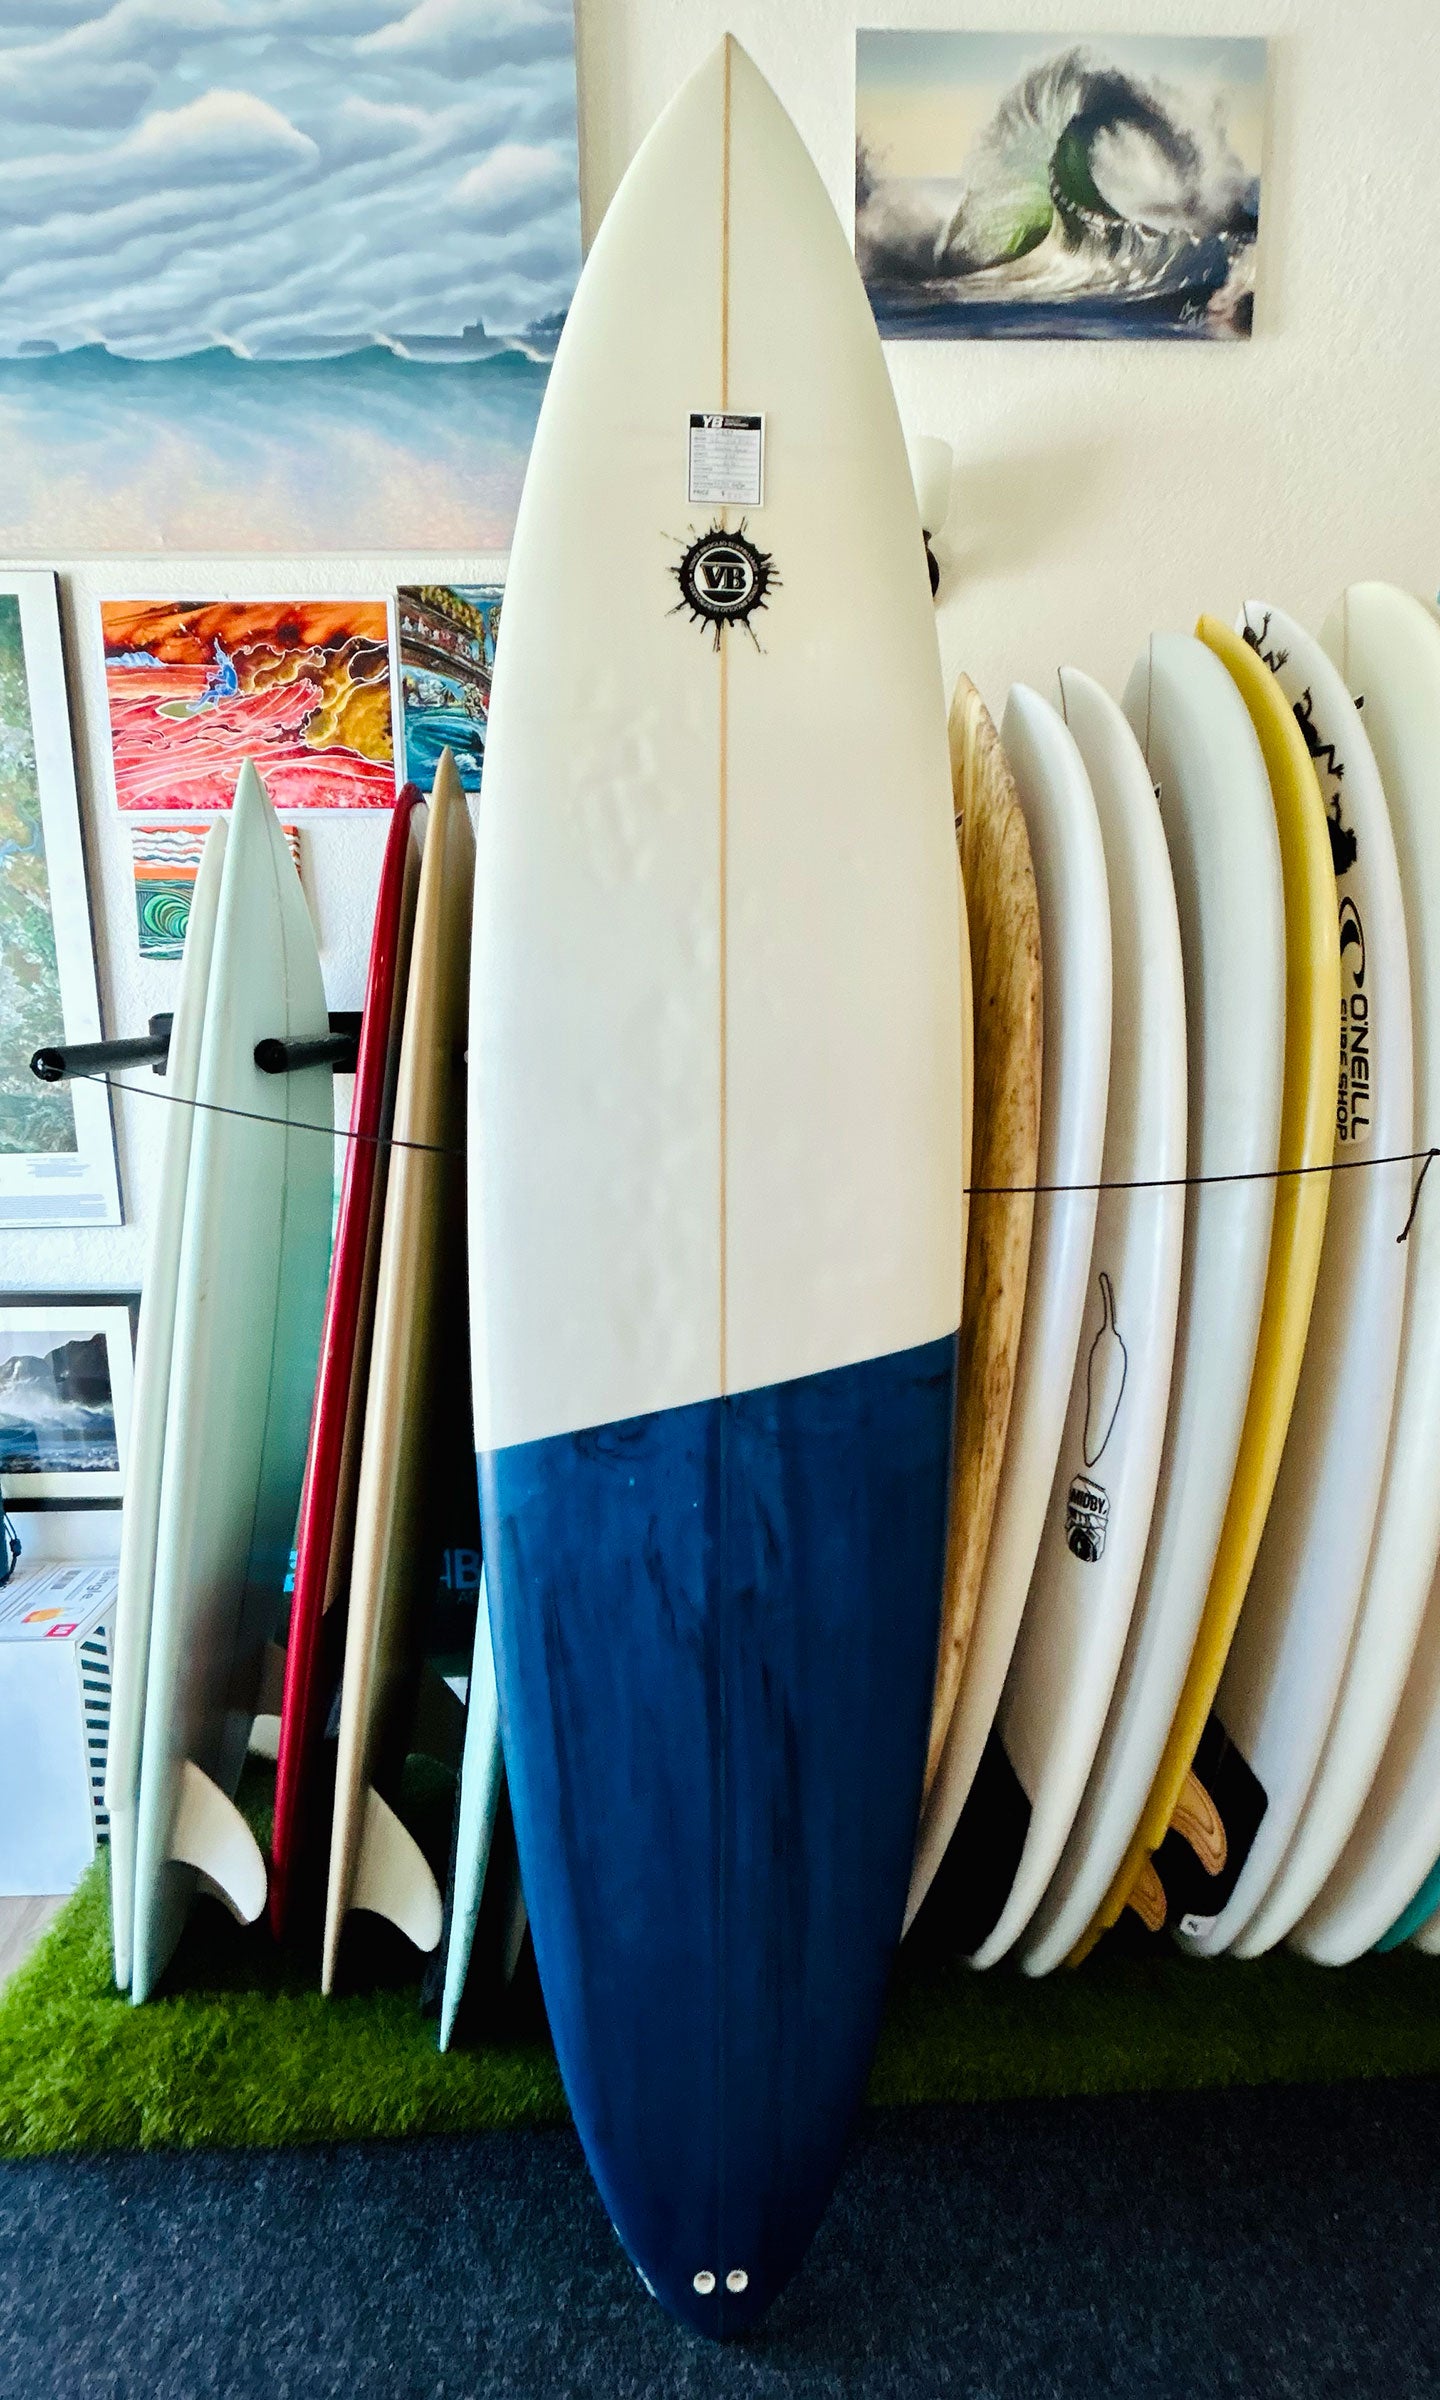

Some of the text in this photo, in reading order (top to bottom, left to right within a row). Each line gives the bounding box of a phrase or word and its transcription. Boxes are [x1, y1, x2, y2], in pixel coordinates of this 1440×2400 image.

[703, 415, 724, 428] YB
[700, 562, 747, 590] VB
[1350, 993, 1370, 1140] O'NEILL
[1336, 1072, 1348, 1141] SHOP
